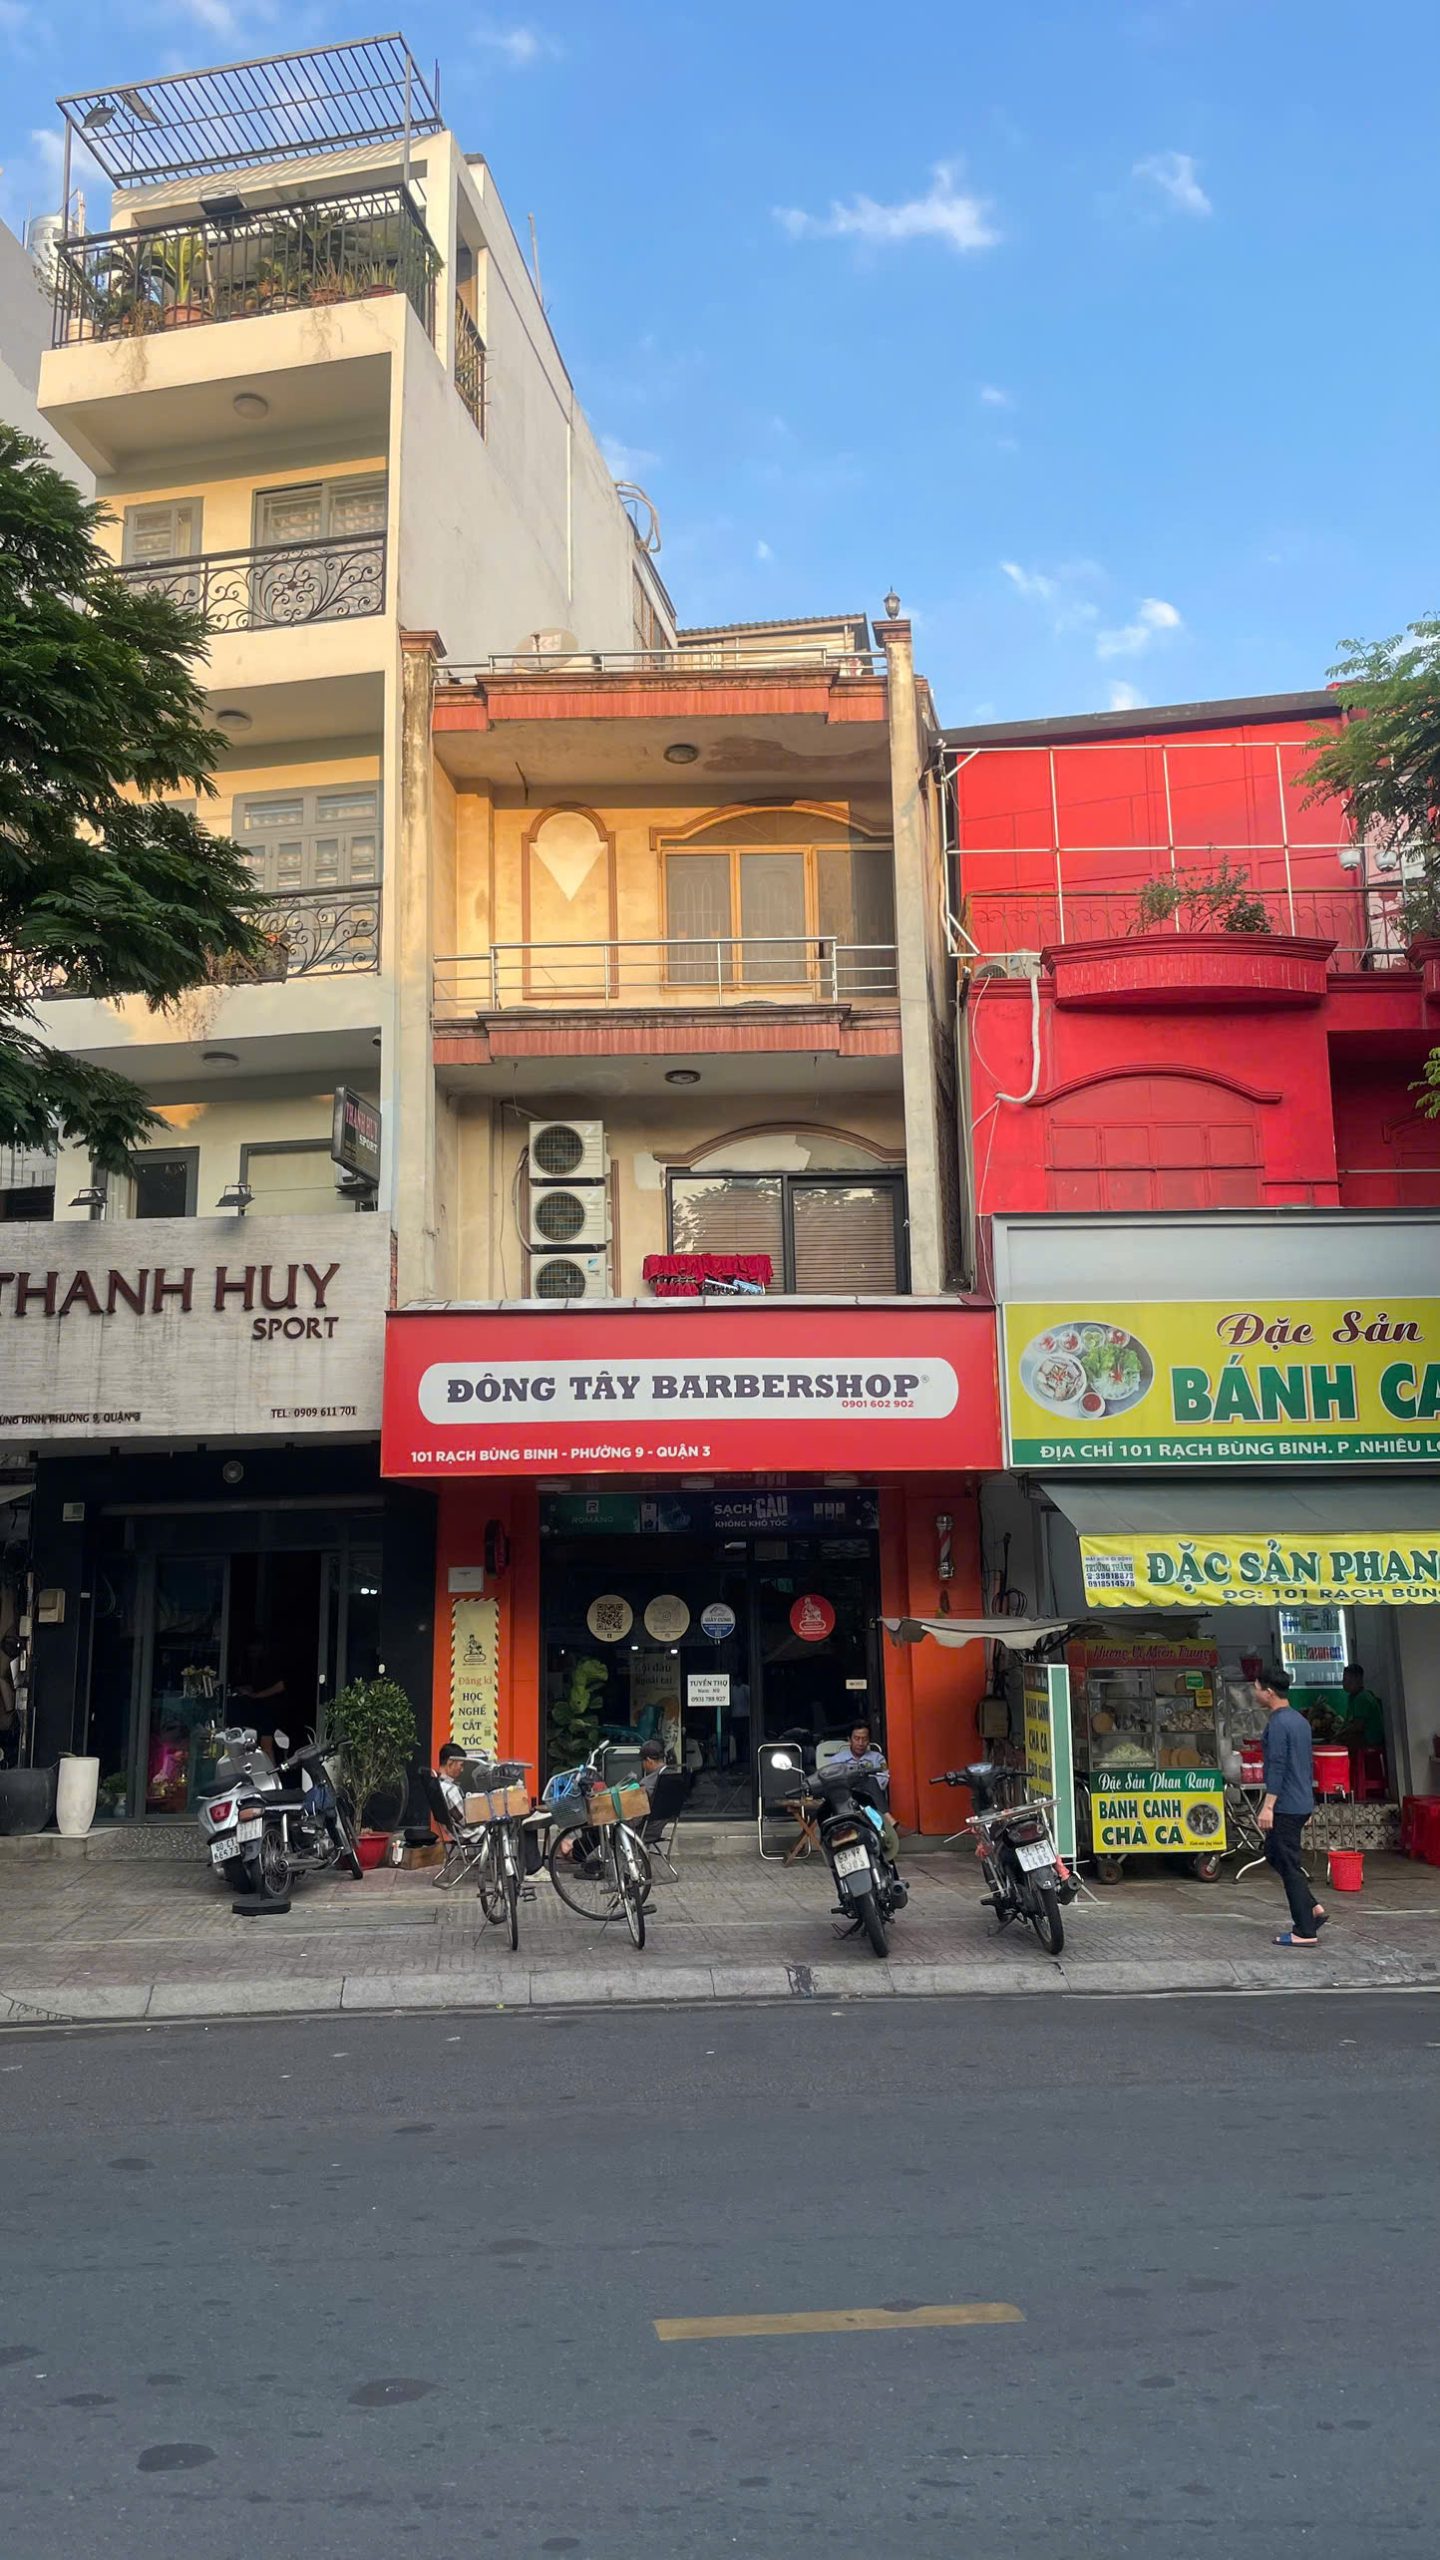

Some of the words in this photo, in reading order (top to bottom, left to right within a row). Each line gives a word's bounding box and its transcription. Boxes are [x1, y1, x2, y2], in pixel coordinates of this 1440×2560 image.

[359, 1134, 378, 1154] SPORT
[214, 1263, 340, 1310] HUY
[252, 1317, 339, 1340] SPORT
[1216, 1312, 1314, 1351] Đặc
[1332, 1311, 1423, 1343] Sản
[448, 1373, 556, 1403] ĐÔNG
[570, 1371, 640, 1400] TÂY
[652, 1374, 920, 1399] BARBERSHOP
[1170, 1354, 1359, 1423] BÁNH
[294, 1407, 318, 1418] 0909
[320, 1406, 337, 1416] 611
[340, 1406, 357, 1416] 701
[841, 1400, 868, 1408] 0901
[870, 1400, 891, 1408] 602
[894, 1400, 915, 1408] 902
[411, 1452, 432, 1463] 101
[436, 1450, 476, 1464] RẠCH
[480, 1447, 520, 1461] BÙNG
[524, 1448, 558, 1460] BINH
[571, 1445, 631, 1459] PHƯỜNG
[635, 1447, 644, 1457] 9
[657, 1446, 699, 1459] QUẬN
[702, 1446, 711, 1457] 3
[1040, 1445, 1075, 1461] ĐỊA
[1080, 1441, 1113, 1457] CHỈ
[1120, 1444, 1152, 1457] 101
[1159, 1443, 1212, 1459] RẠCH
[1218, 1440, 1273, 1455] BÙNG
[1427, 1440, 1440, 1452] L
[714, 1503, 752, 1517] SẠCH
[715, 1518, 746, 1528] KHÔNG
[770, 1518, 789, 1527] TÓC
[1147, 1541, 1231, 1594] ĐẶC
[1239, 1539, 1321, 1584] SẢN
[1330, 1550, 1439, 1584] PHAN
[1222, 1589, 1262, 1599] ĐC:
[1272, 1588, 1308, 1599] 101
[1320, 1589, 1383, 1600] RẠCH
[1392, 1586, 1440, 1598] BÙN
[463, 1692, 483, 1703] HỌC
[463, 1733, 482, 1745] TÓC
[1150, 1772, 1182, 1792] Phan
[1186, 1772, 1216, 1792] Rang
[1099, 1796, 1139, 1819] BÁNH
[1143, 1799, 1182, 1818] CANH
[1102, 1820, 1148, 1845] CHẢ
[1155, 1821, 1184, 1844] CÁ
